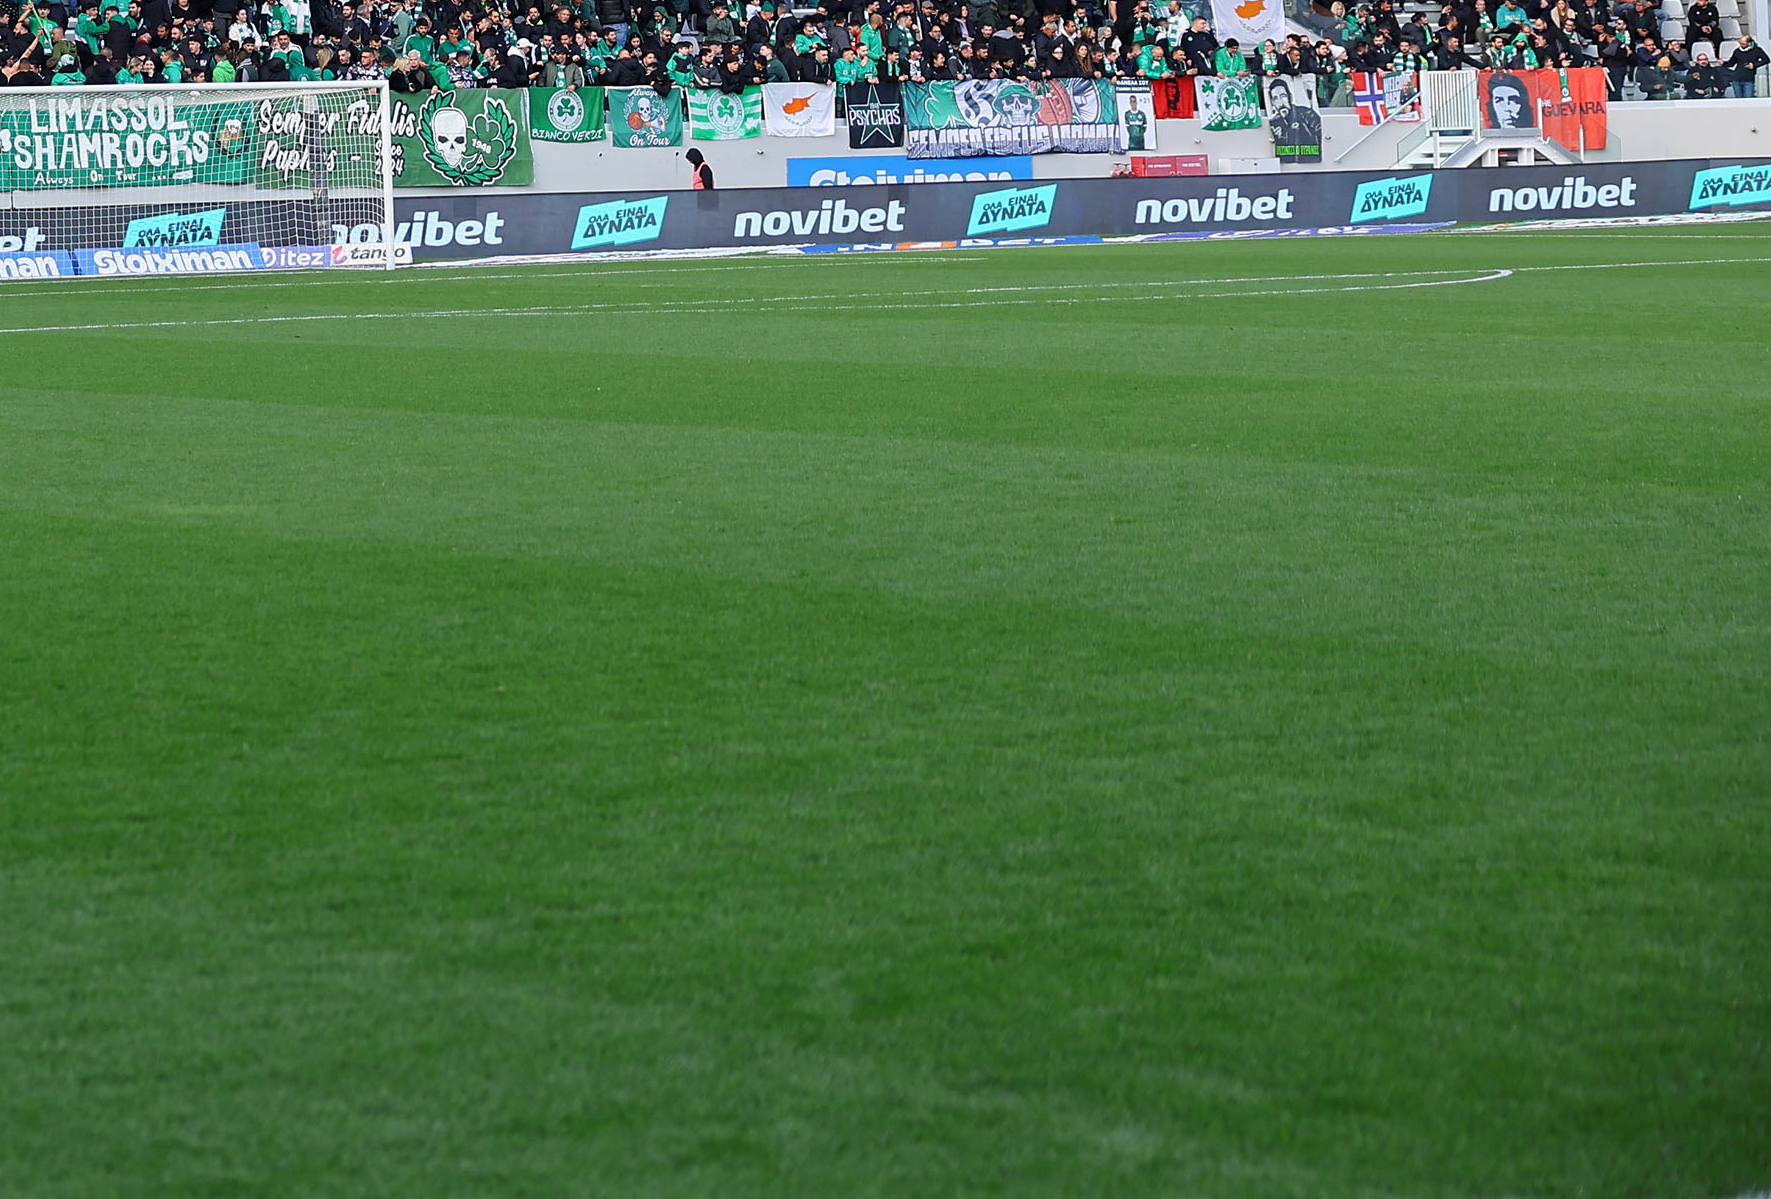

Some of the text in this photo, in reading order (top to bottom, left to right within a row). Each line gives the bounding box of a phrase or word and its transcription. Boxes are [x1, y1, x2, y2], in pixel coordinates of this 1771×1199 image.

[29, 96, 188, 133] LIMASSOL
[347, 99, 416, 137] Fidlis
[1542, 101, 1606, 117] GUEVARA
[532, 128, 604, 141] BIANCO VERDI
[630, 134, 671, 146] On Tour
[14, 130, 209, 170] SHAMROCKS
[472, 137, 492, 154] 1948
[261, 140, 337, 182] Paphs
[375, 158, 404, 176] 224
[34, 171, 74, 186] Always
[90, 170, 104, 182] On
[115, 171, 137, 181] Tour
[1703, 170, 1769, 186] ΟΛΑ ΕΙΝΑΙ
[1360, 189, 1424, 213] ΔΥΝΑΤΑ
[1364, 183, 1416, 201] ΟΛΑ ΕΙΝΑΙ
[1489, 177, 1636, 213] novibet
[983, 193, 1038, 211] ΟΛΑ ΕΙΝΑΙ
[1135, 188, 1294, 224] novibet
[589, 205, 648, 223] ΟΛΑ ΕΙΝΑΙ
[734, 200, 905, 237] novibet
[978, 201, 1046, 225] ΔΥΝΑΤΑ
[138, 227, 161, 237] ΟΛΑ
[584, 212, 656, 236] ΔΥΝΑΤΑ
[94, 249, 254, 274] Stoiximan
[280, 249, 324, 266] itez
